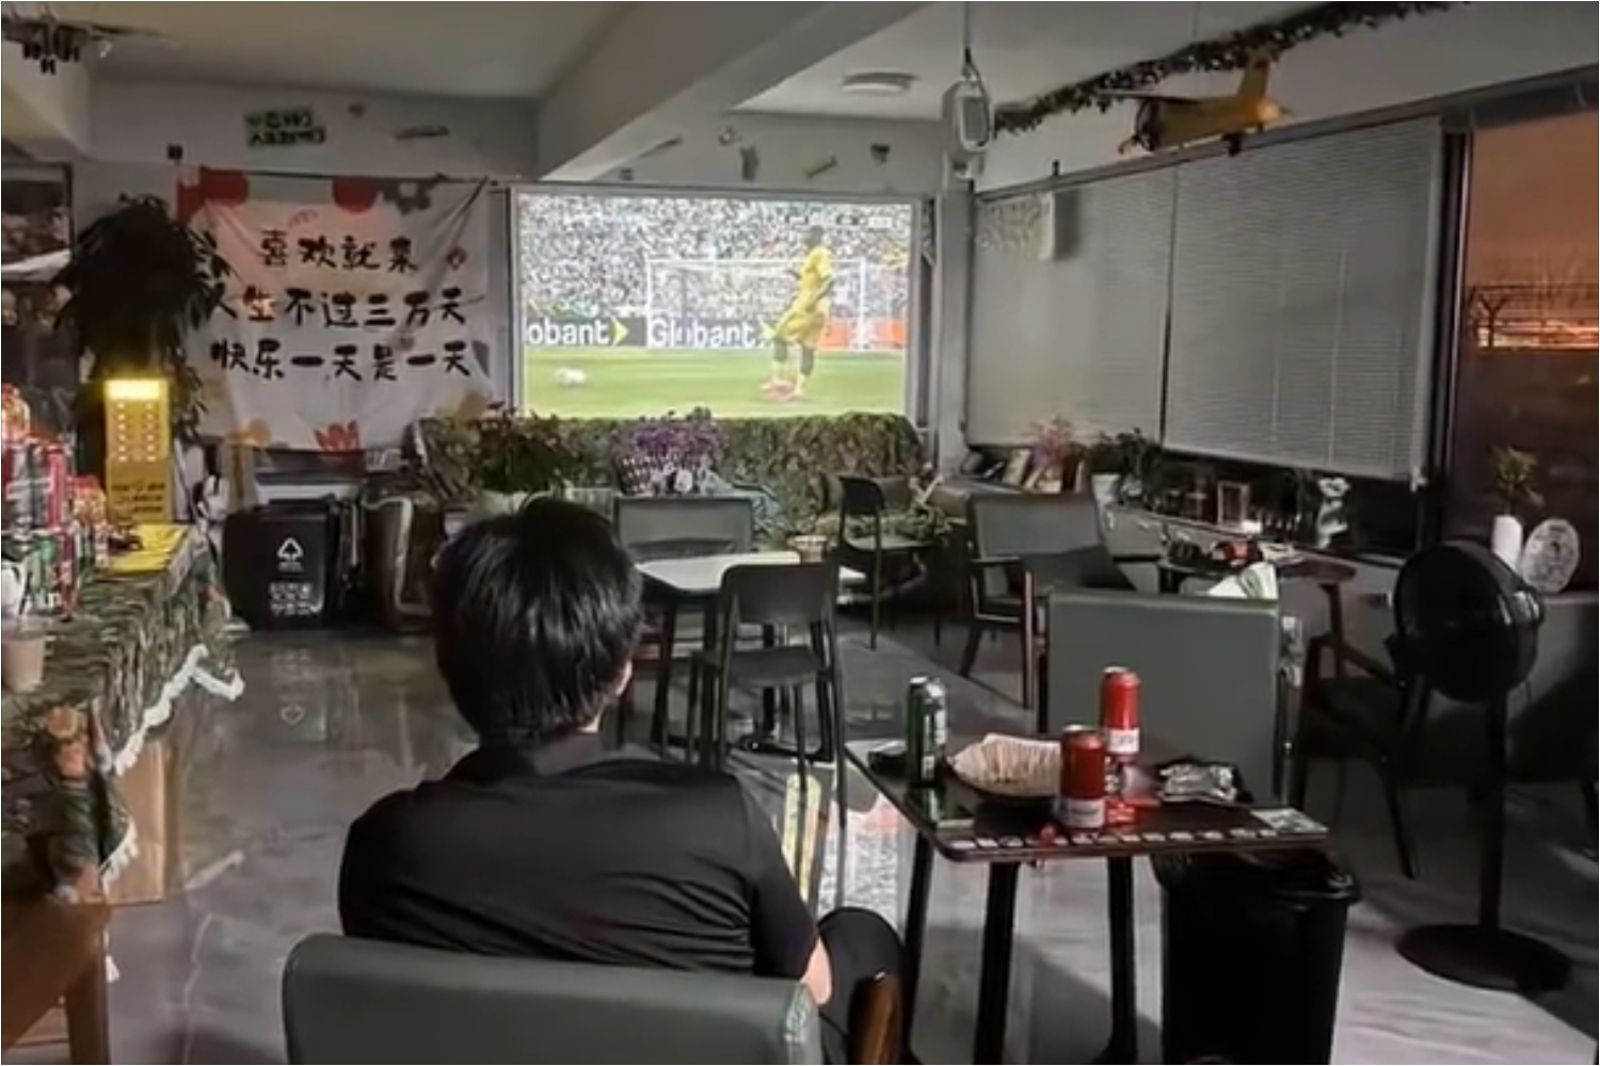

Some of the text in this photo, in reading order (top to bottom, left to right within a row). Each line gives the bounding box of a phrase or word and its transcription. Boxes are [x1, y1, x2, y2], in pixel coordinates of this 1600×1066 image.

[261, 230, 419, 273] 喜欢就来
[209, 283, 468, 328] 人生不过三万天
[527, 318, 610, 345] obant
[211, 338, 471, 382] 快乐一天是一天
